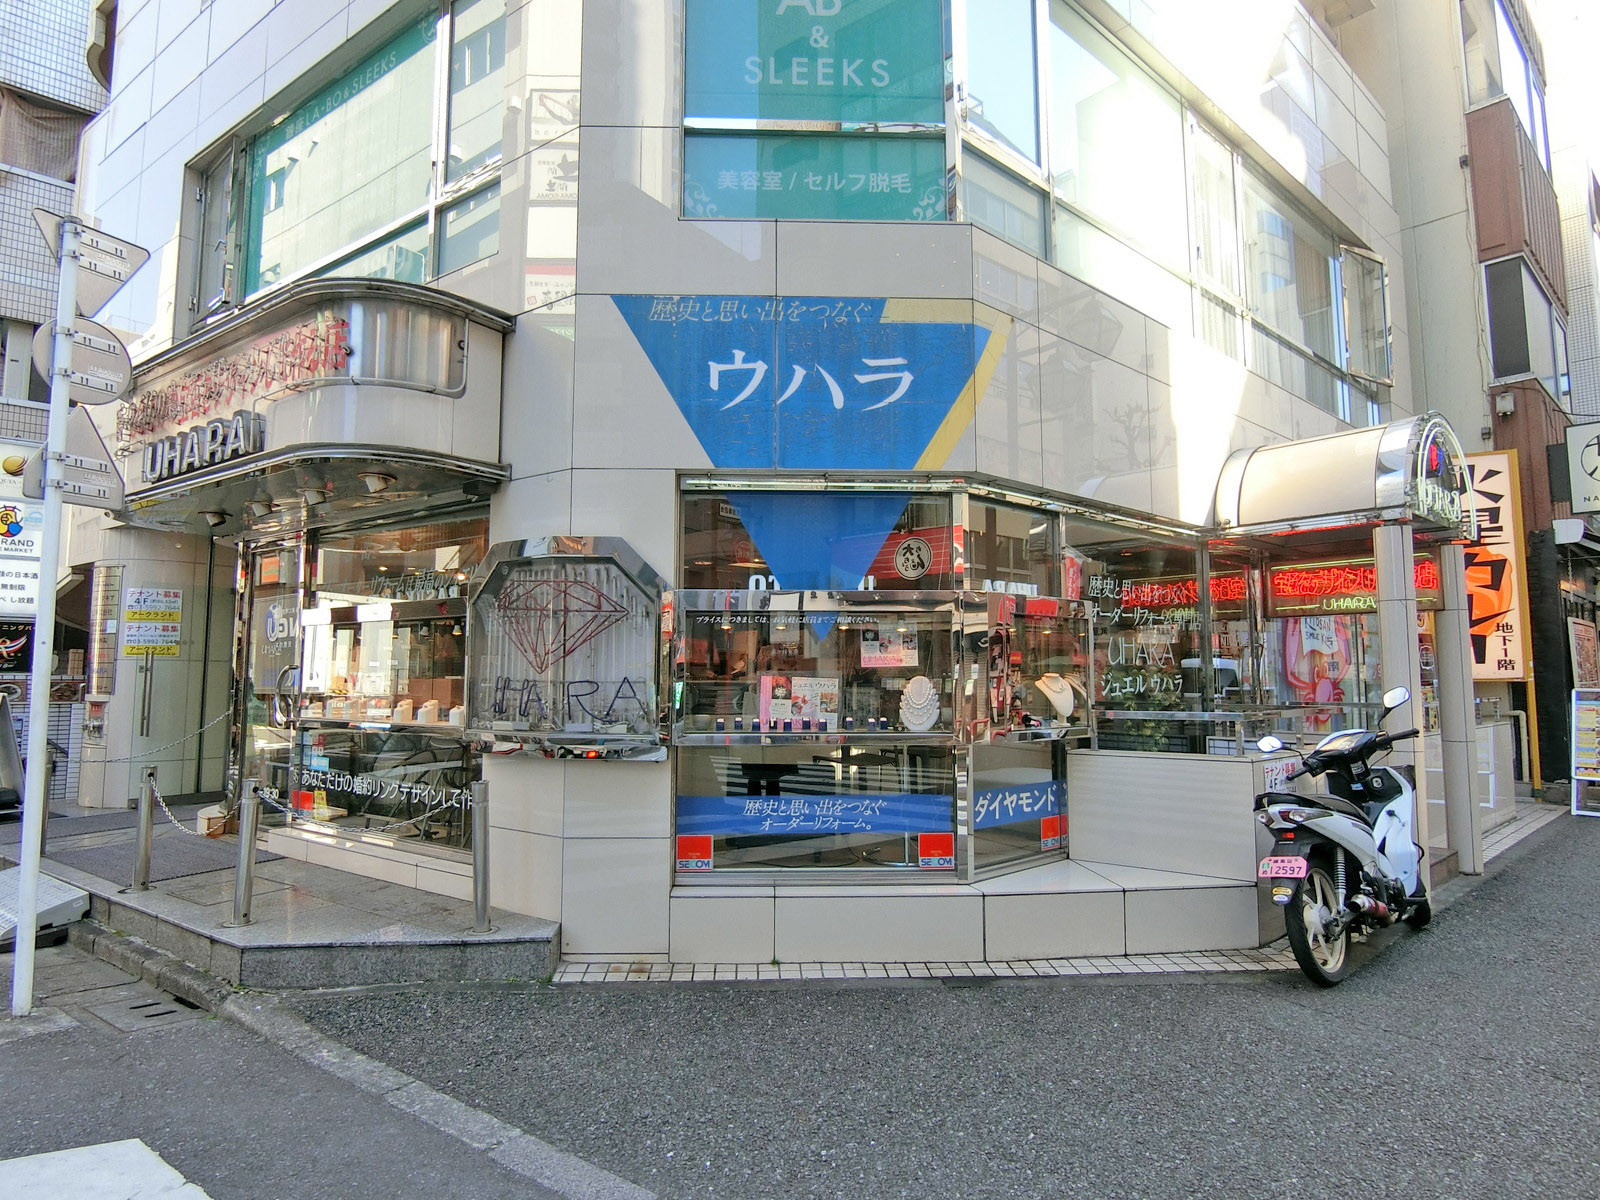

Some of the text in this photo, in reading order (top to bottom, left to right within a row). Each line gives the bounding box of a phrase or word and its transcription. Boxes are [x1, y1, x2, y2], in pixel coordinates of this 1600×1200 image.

[809, 25, 829, 48] &
[352, 51, 397, 94] SLEEKS
[743, 56, 891, 88] SLEEKS
[717, 169, 783, 191] 美容室
[804, 171, 912, 194] セルフ脱毛
[648, 298, 873, 323] 歴史と思い出をつなぐ
[707, 349, 914, 412] ウハラ
[144, 410, 263, 483] UHARA
[128, 590, 181, 599] テナント募集
[126, 624, 180, 633] テナント募集
[1107, 637, 1175, 669] UHARA
[1495, 622, 1516, 671] 地下1階
[742, 798, 887, 817] 歴史と思い出をつなぐ
[975, 784, 1057, 823] ダイヤモンド
